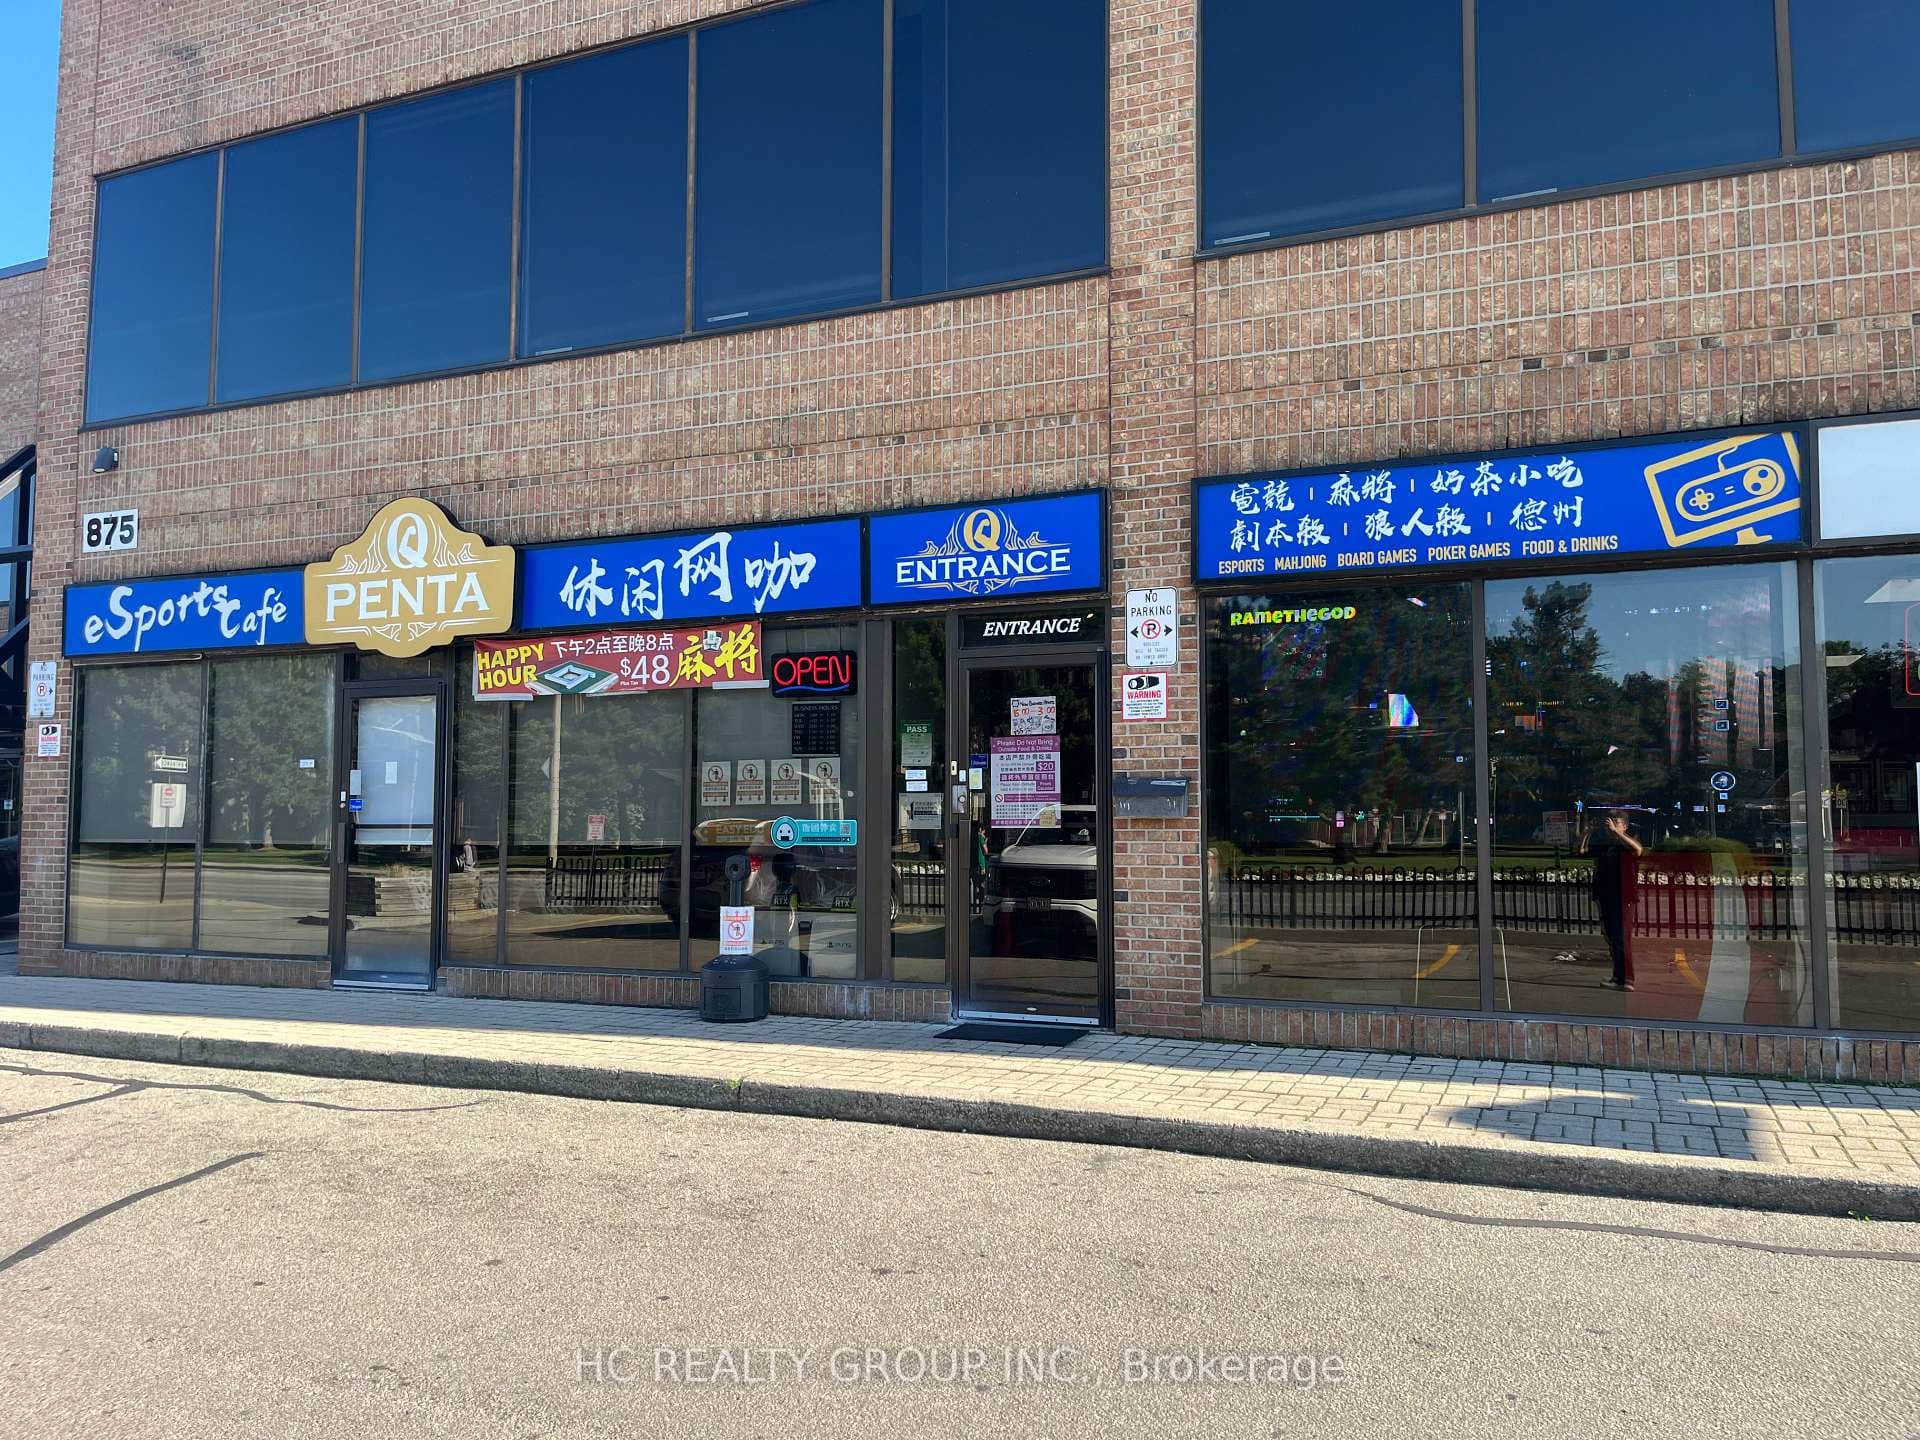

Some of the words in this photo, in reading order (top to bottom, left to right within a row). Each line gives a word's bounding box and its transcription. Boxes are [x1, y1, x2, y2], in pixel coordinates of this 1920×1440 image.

[1429, 456, 1584, 497] 奶茶小吃
[86, 514, 134, 548] 875
[1364, 503, 1472, 542] 狼人殺
[896, 548, 1071, 584] ENTRANCE
[1218, 559, 1265, 575] ESPORTS
[1275, 554, 1327, 571] MAHJONG
[1337, 551, 1374, 567] BOARD
[1377, 548, 1417, 565] GAMES
[1428, 545, 1466, 562] POKER
[1469, 542, 1511, 559] GAMES
[1522, 540, 1555, 556] FOOD
[1558, 539, 1568, 554] &
[1571, 535, 1618, 553] DRINKS
[559, 531, 817, 620] 休闲网咖
[326, 571, 490, 622] PENTA
[1131, 605, 1172, 617] PARKING
[1145, 592, 1158, 603] NO
[84, 581, 229, 652] eSports
[212, 587, 288, 646] Café
[982, 617, 1082, 637] ENTRANCE
[476, 643, 545, 671] HAPPY
[551, 632, 674, 659] 下午2点至晚8点
[479, 664, 538, 691] HOUR
[619, 654, 671, 685] $48
[773, 655, 851, 686] OPEN
[1127, 690, 1162, 699] WARNING
[1037, 762, 1054, 771] $20
